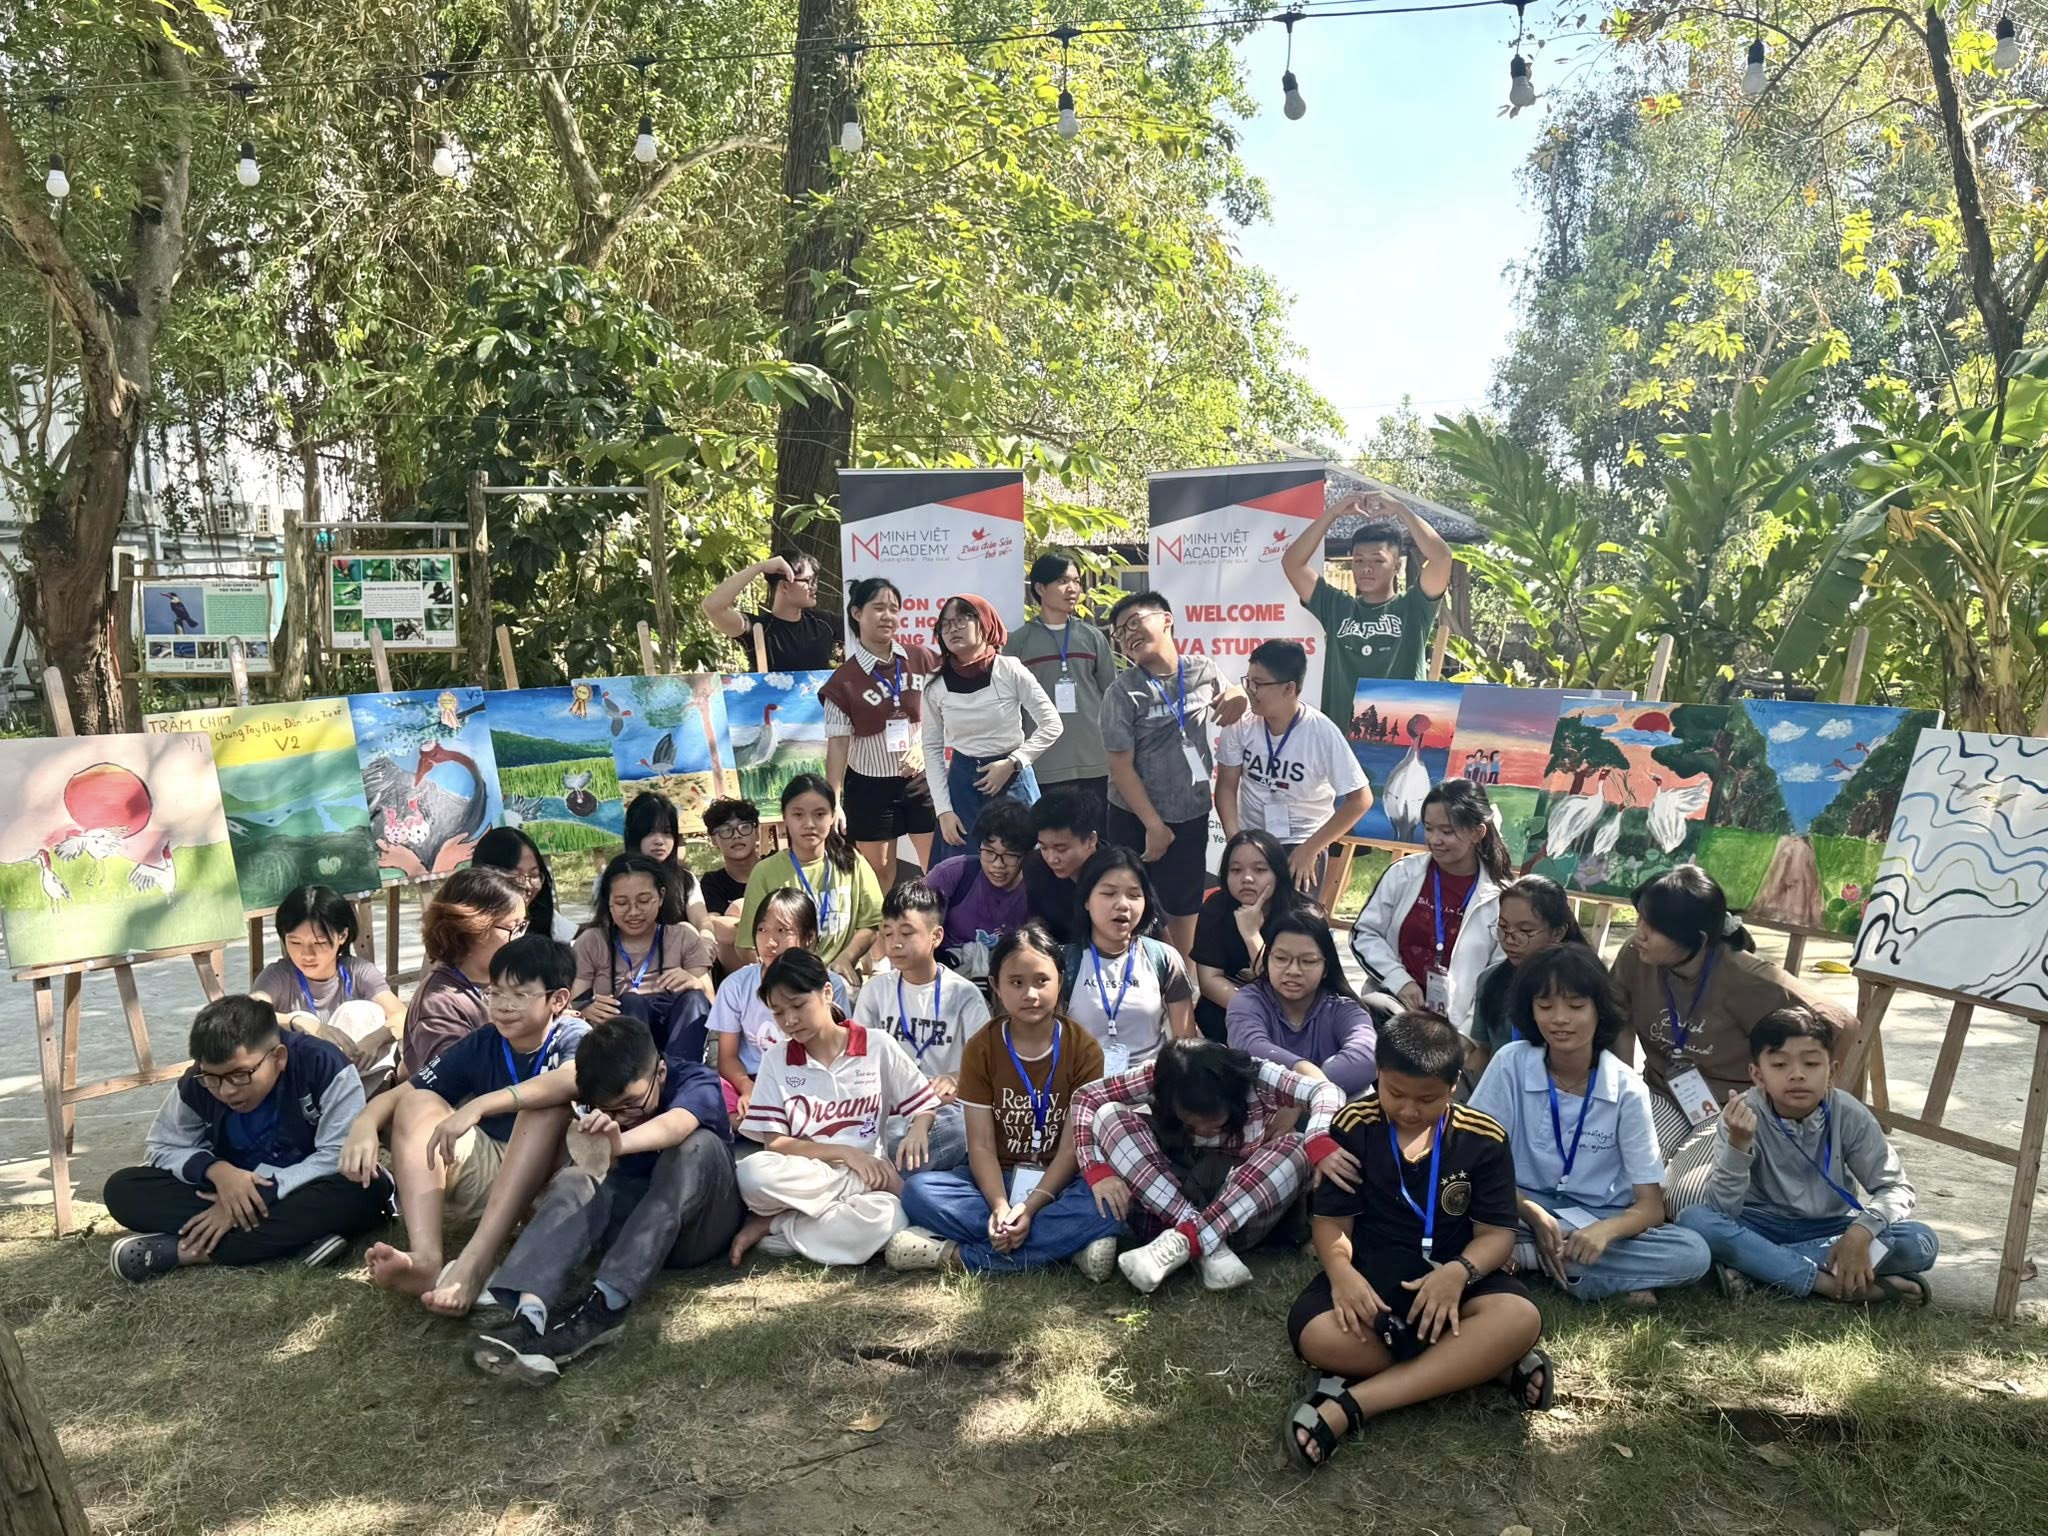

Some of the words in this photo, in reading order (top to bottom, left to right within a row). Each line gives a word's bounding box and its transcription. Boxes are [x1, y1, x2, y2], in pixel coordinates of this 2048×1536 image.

[879, 530, 916, 542] MINH
[1183, 533, 1217, 545] MINH
[880, 543, 949, 557] ACADEMY
[1183, 546, 1248, 560] ACADEMY
[1184, 604, 1286, 623] WELCOME
[148, 715, 193, 734] TRÀM
[274, 735, 301, 752] V2
[1242, 748, 1305, 783] PARIS
[784, 1093, 882, 1138] Dreamy
[1002, 1119, 1025, 1142] by
[1007, 1135, 1055, 1154] mid
